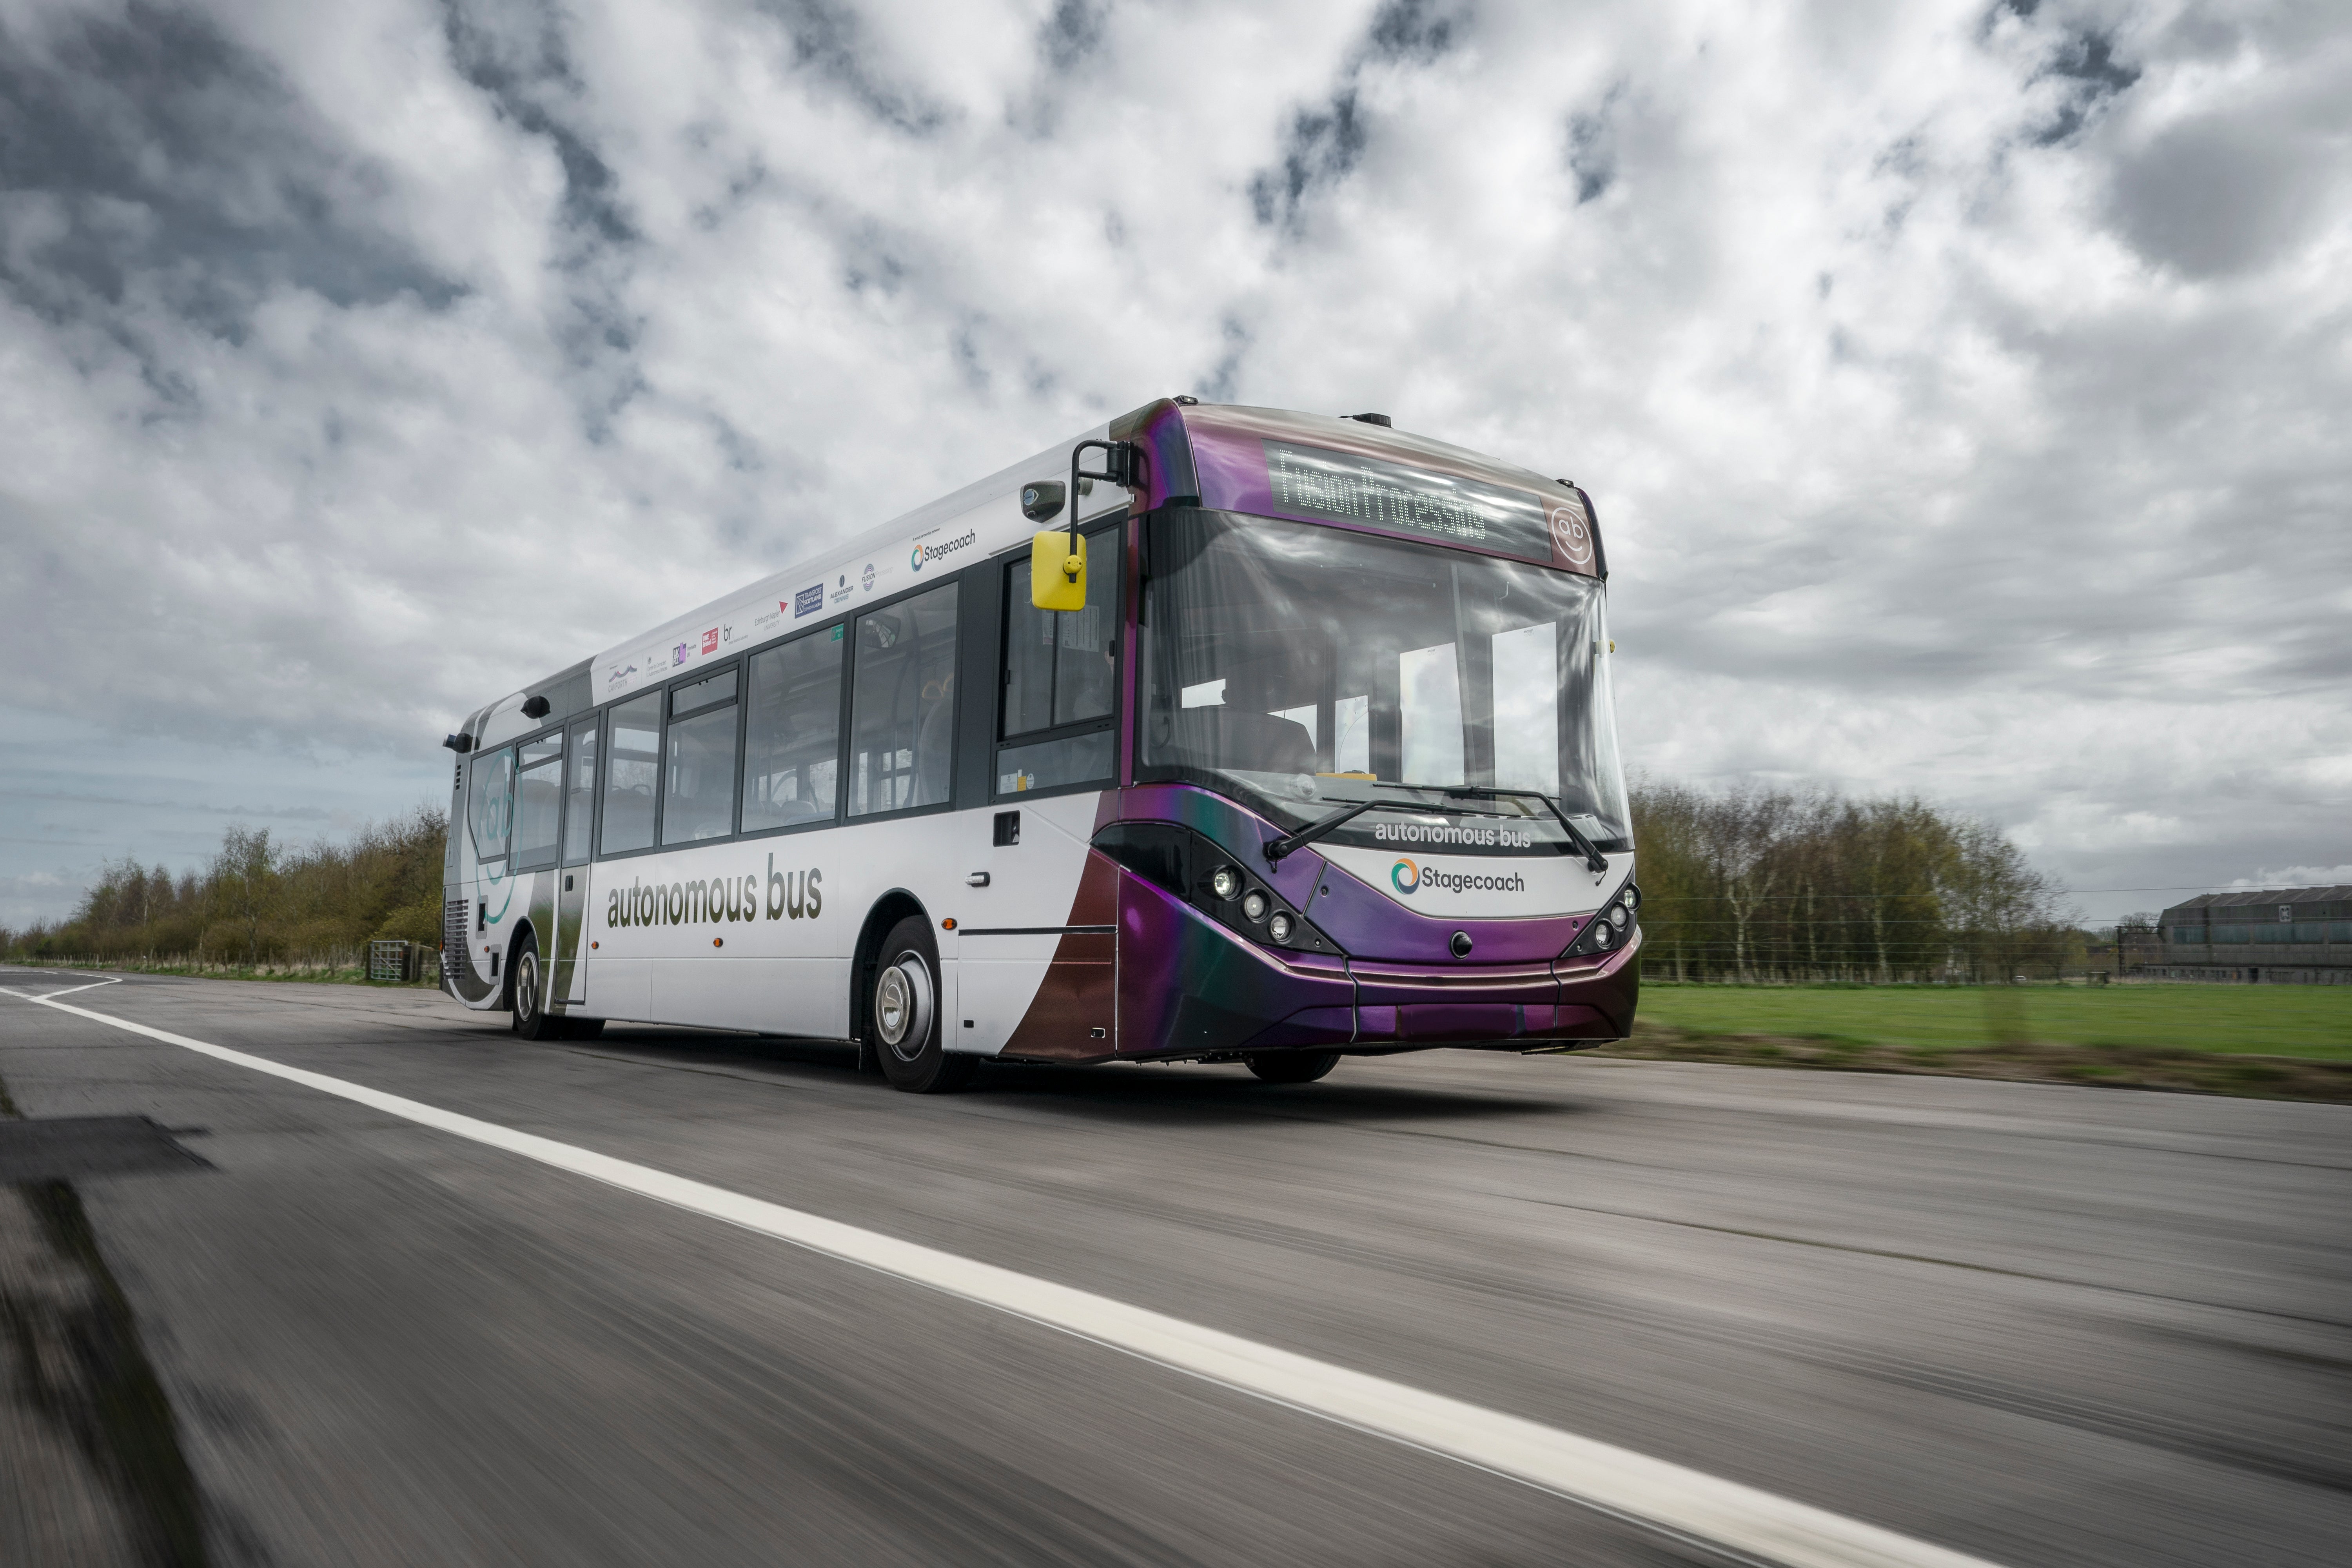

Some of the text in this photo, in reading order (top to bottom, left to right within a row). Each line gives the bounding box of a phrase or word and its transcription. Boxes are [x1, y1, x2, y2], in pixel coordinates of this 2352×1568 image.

[1279, 449, 1486, 539] Fusion Processing
[1559, 516, 1583, 539] ab
[924, 528, 975, 562] Stagecoach
[862, 572, 876, 583] FUSION
[804, 587, 822, 599] TRANSPORT
[804, 594, 822, 605] SCOTLAND
[830, 586, 853, 599] ALEXANDER
[834, 594, 849, 604] DENNIS
[755, 610, 780, 626] Edinburgh Napier
[764, 620, 780, 631] UNIVERSITY
[1375, 822, 1531, 848] autonomous bus
[1422, 867, 1524, 894] Stagecoach
[608, 852, 822, 929] autonomous bus
